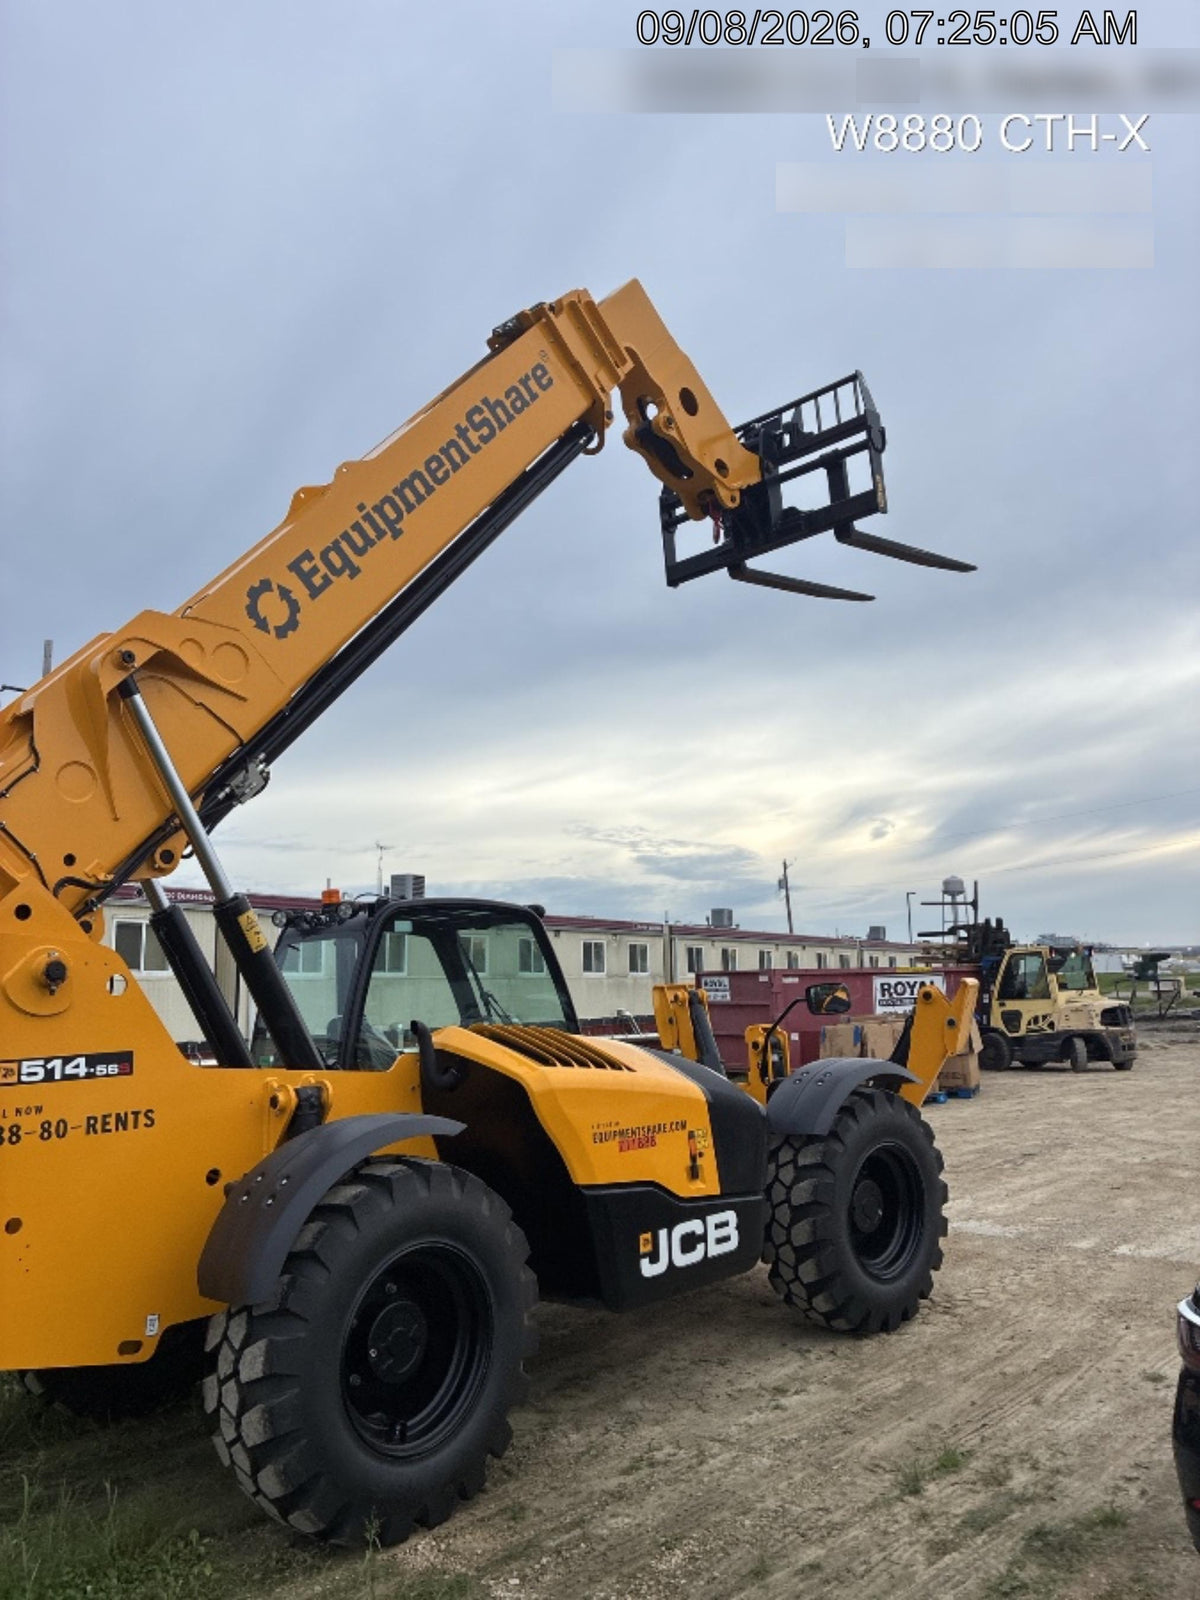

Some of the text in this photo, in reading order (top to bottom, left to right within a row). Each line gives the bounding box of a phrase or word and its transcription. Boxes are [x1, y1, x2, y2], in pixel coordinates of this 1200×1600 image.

[287, 361, 554, 601] EquipmentShare
[880, 981, 935, 998] ROY
[15, 1105, 43, 1118] NOW
[640, 1210, 739, 1278] JCB
